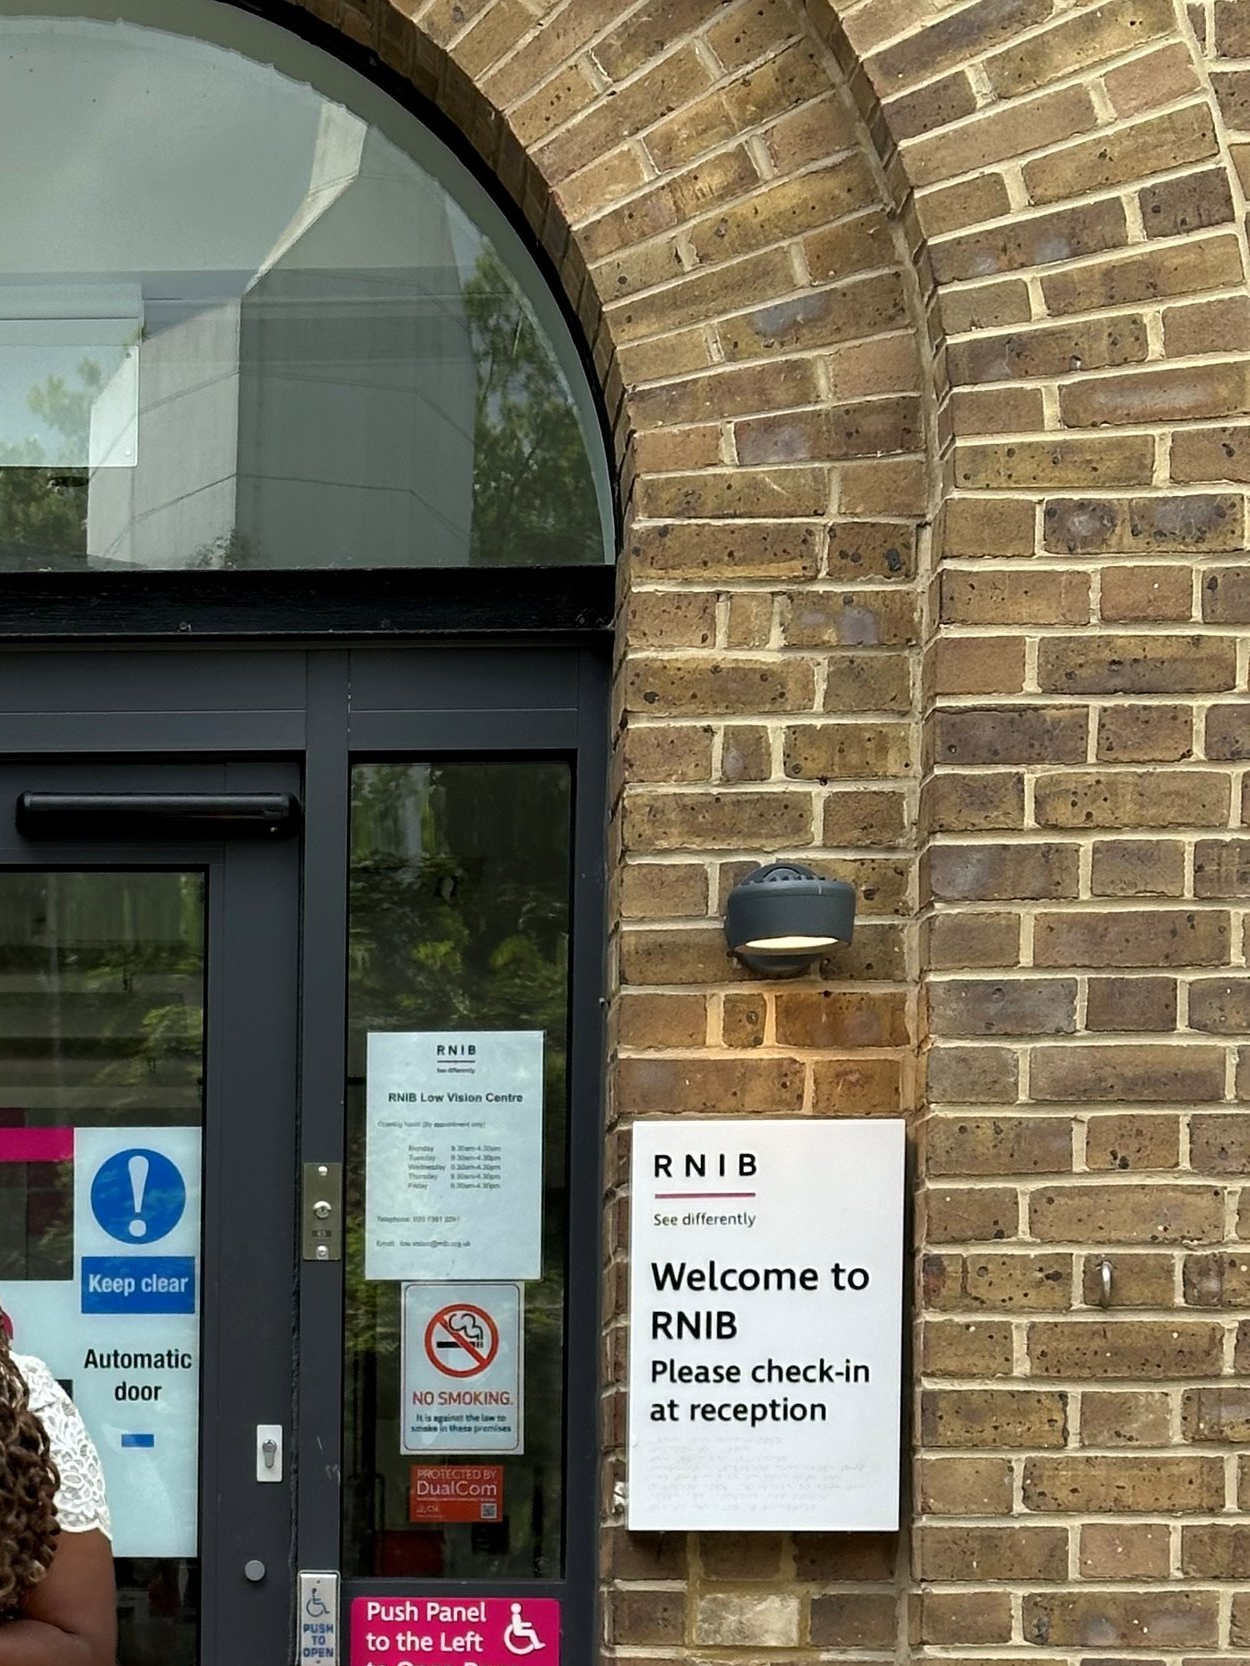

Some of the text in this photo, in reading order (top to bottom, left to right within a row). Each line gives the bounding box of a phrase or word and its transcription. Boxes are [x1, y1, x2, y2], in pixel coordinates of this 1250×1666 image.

[436, 1044, 477, 1056] RNIB
[388, 1092, 523, 1103] RNIB Low Vision Centre
[654, 1153, 757, 1178] RNIB
[654, 1212, 756, 1228] See differently
[650, 1260, 870, 1291] Welcome to
[88, 1272, 189, 1298] Keep clear
[651, 1310, 738, 1341] RNIB
[83, 1348, 193, 1370] Automatic
[650, 1358, 871, 1384] Please check-in
[114, 1381, 162, 1401] door
[412, 1391, 434, 1406] NO
[433, 1414, 464, 1424] against
[465, 1414, 479, 1422] the
[481, 1414, 495, 1422] law
[497, 1414, 507, 1422] to
[650, 1396, 827, 1428] at reception
[410, 1424, 438, 1433] smoke
[439, 1424, 448, 1433] in
[473, 1424, 512, 1435] premises
[417, 1469, 497, 1480] PROTECTED BY
[416, 1481, 497, 1496] DualCom
[366, 1601, 487, 1622] Push Panel
[303, 1623, 334, 1634] PUSH
[311, 1635, 327, 1646] TO
[366, 1630, 484, 1652] to the Left
[303, 1647, 334, 1658] OPEN
